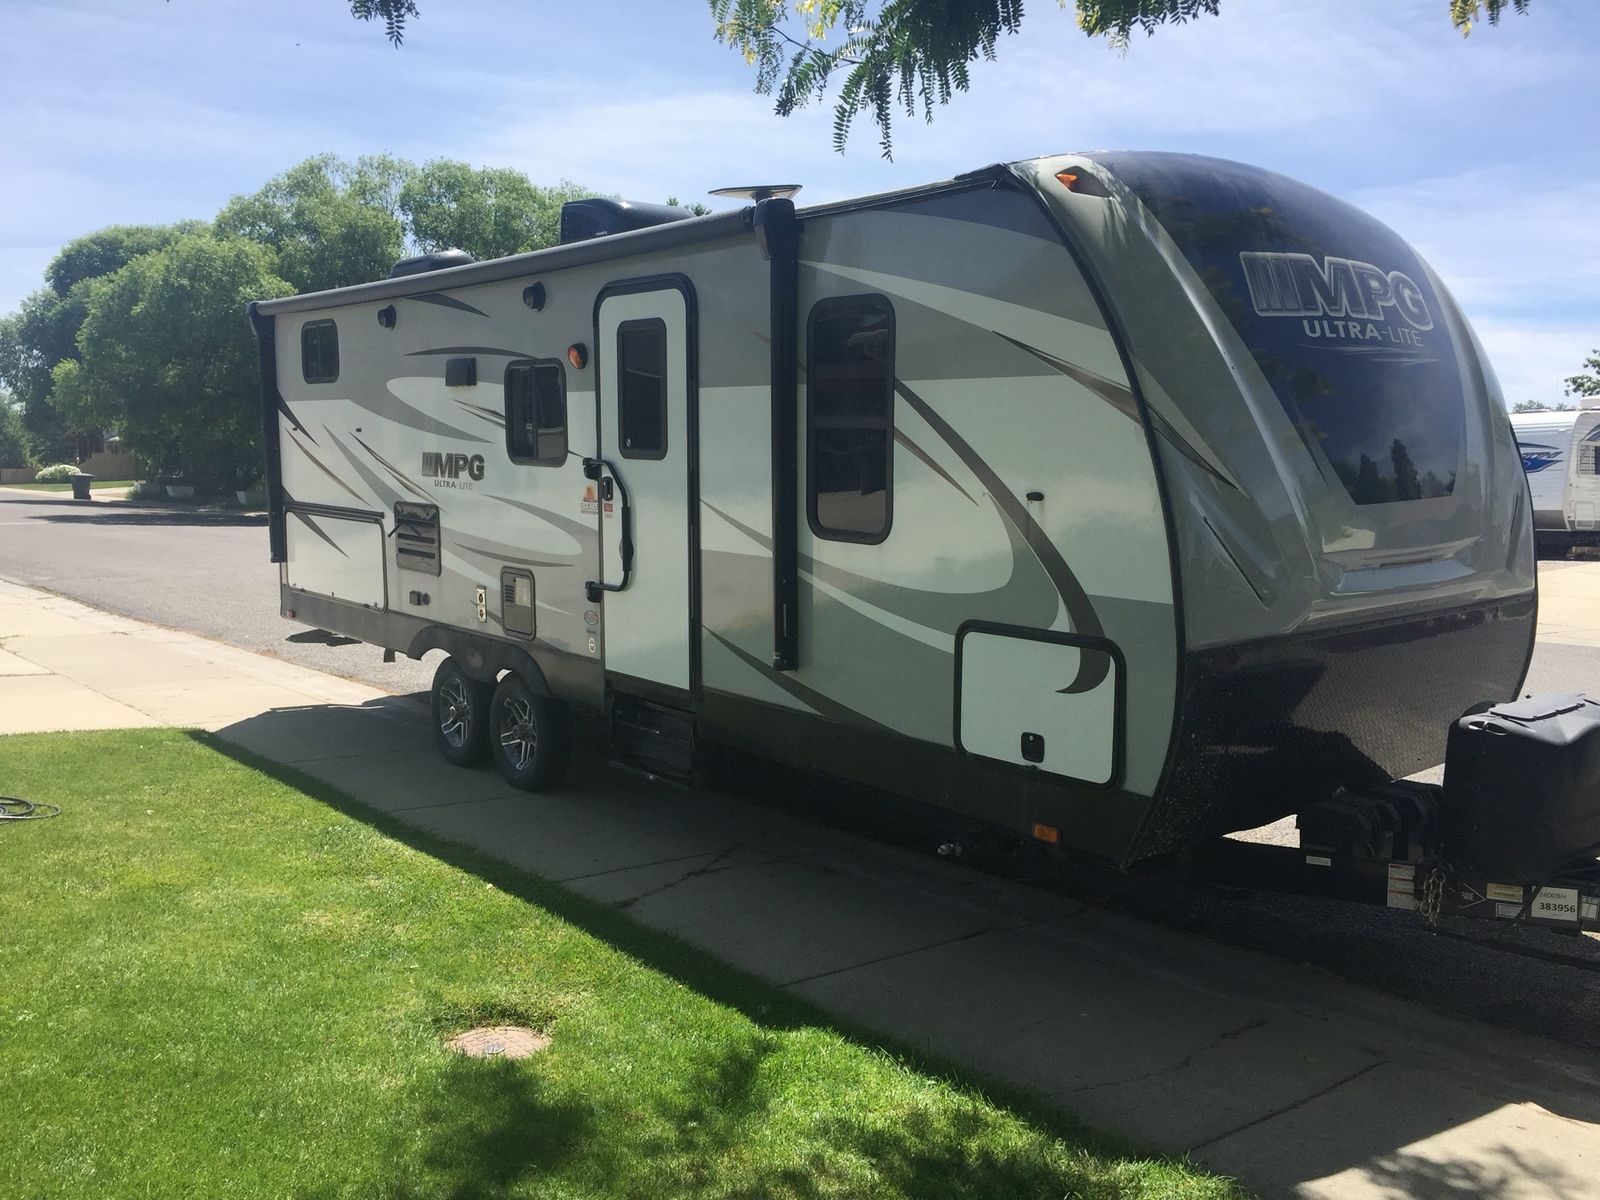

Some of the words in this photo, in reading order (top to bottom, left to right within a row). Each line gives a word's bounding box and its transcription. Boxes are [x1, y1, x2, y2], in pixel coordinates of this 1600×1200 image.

[1286, 253, 1433, 330] MPG
[1303, 320, 1424, 347] ULTRA-LITE
[432, 452, 485, 481] MPG
[434, 480, 473, 491] ULTRA-LITE
[1540, 902, 1577, 913] 383956
